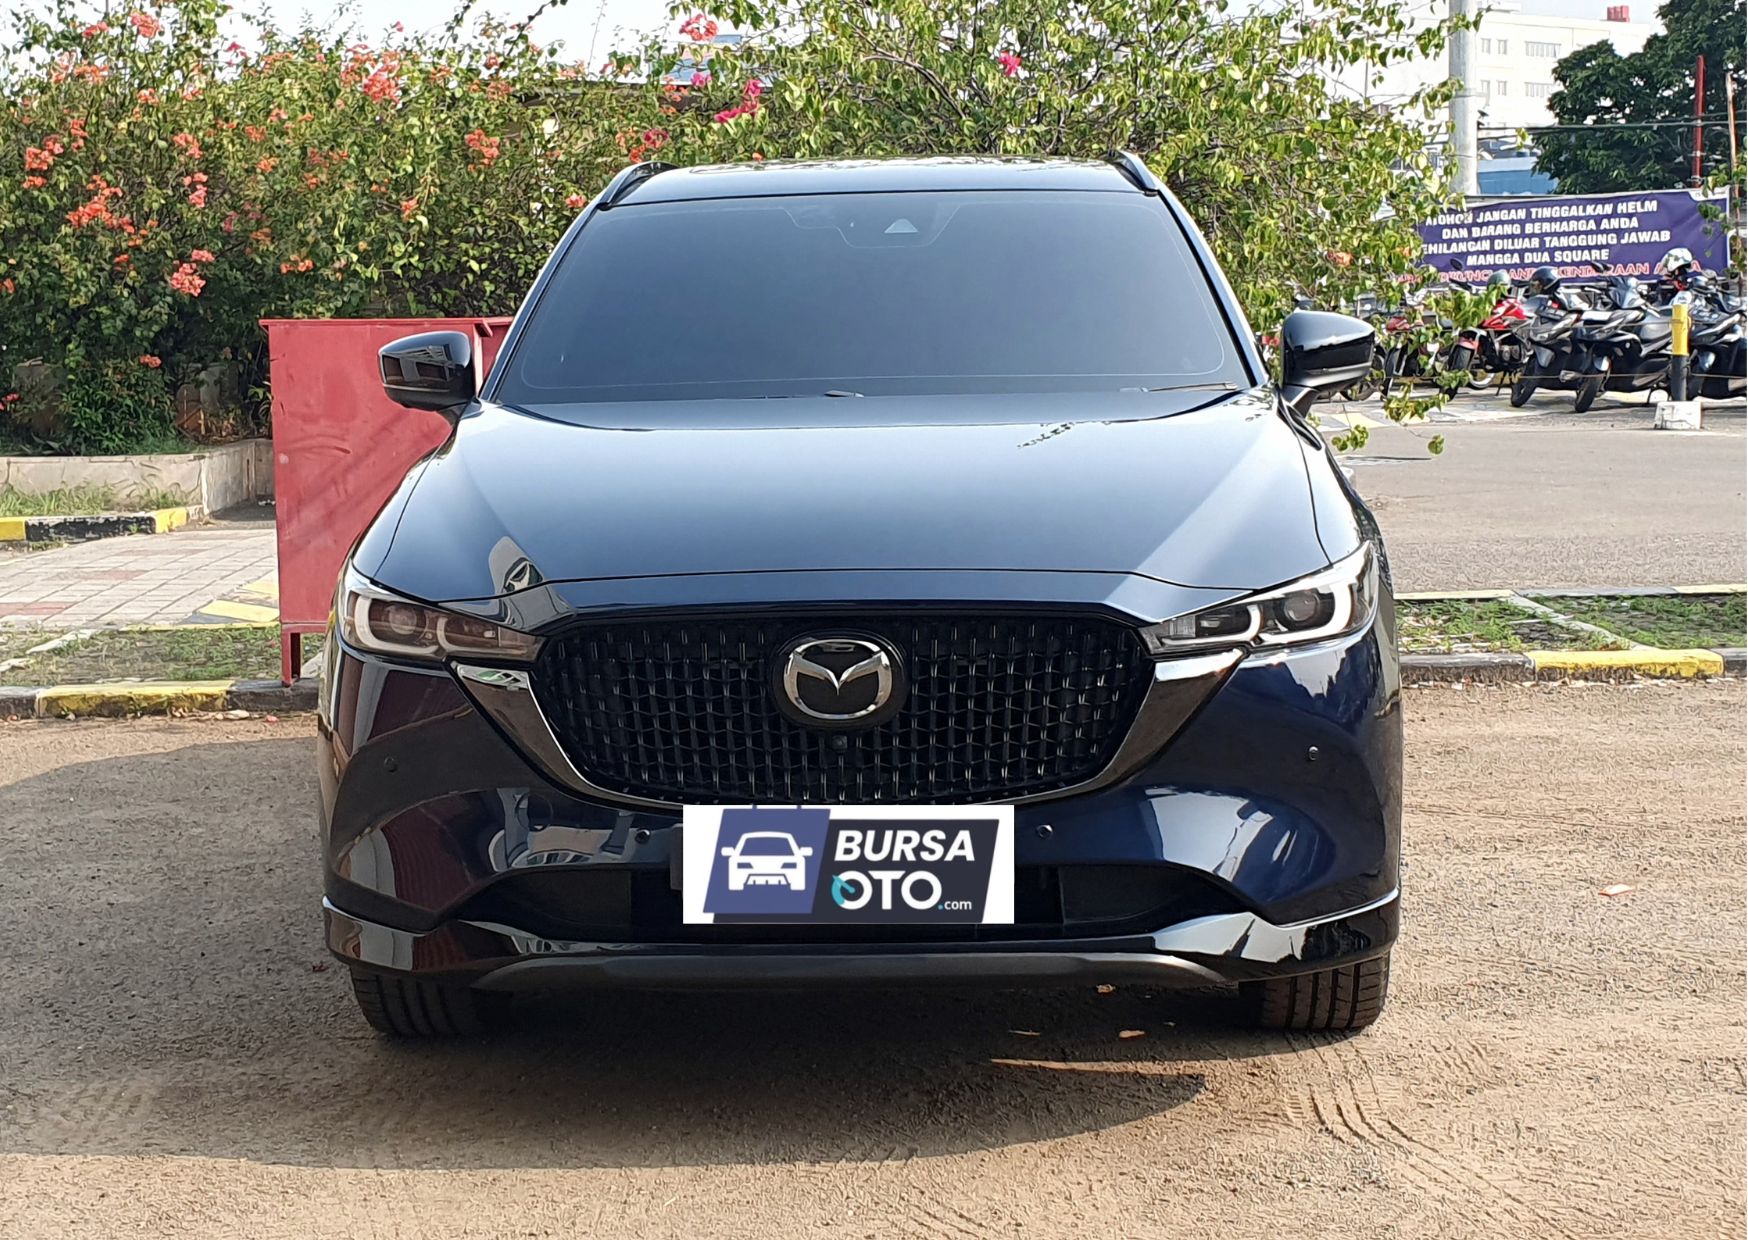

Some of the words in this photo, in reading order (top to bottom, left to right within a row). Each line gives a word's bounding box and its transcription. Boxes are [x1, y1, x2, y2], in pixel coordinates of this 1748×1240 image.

[1476, 208, 1526, 222] JANGAN
[1530, 203, 1613, 219] TINGGALKAN
[1617, 200, 1658, 214] HELM
[1442, 226, 1469, 240] DAN
[1472, 223, 1521, 238] BARANG
[1525, 220, 1596, 234] BERHARGA
[1600, 217, 1639, 230] ANDA
[1494, 237, 1540, 251] DILUAR
[1543, 233, 1618, 248] TANGGUNG
[1620, 230, 1671, 244] JAWAB
[1466, 252, 1520, 266] MANGGA
[1524, 250, 1551, 264] DUA
[1554, 249, 1609, 263] SQUARE
